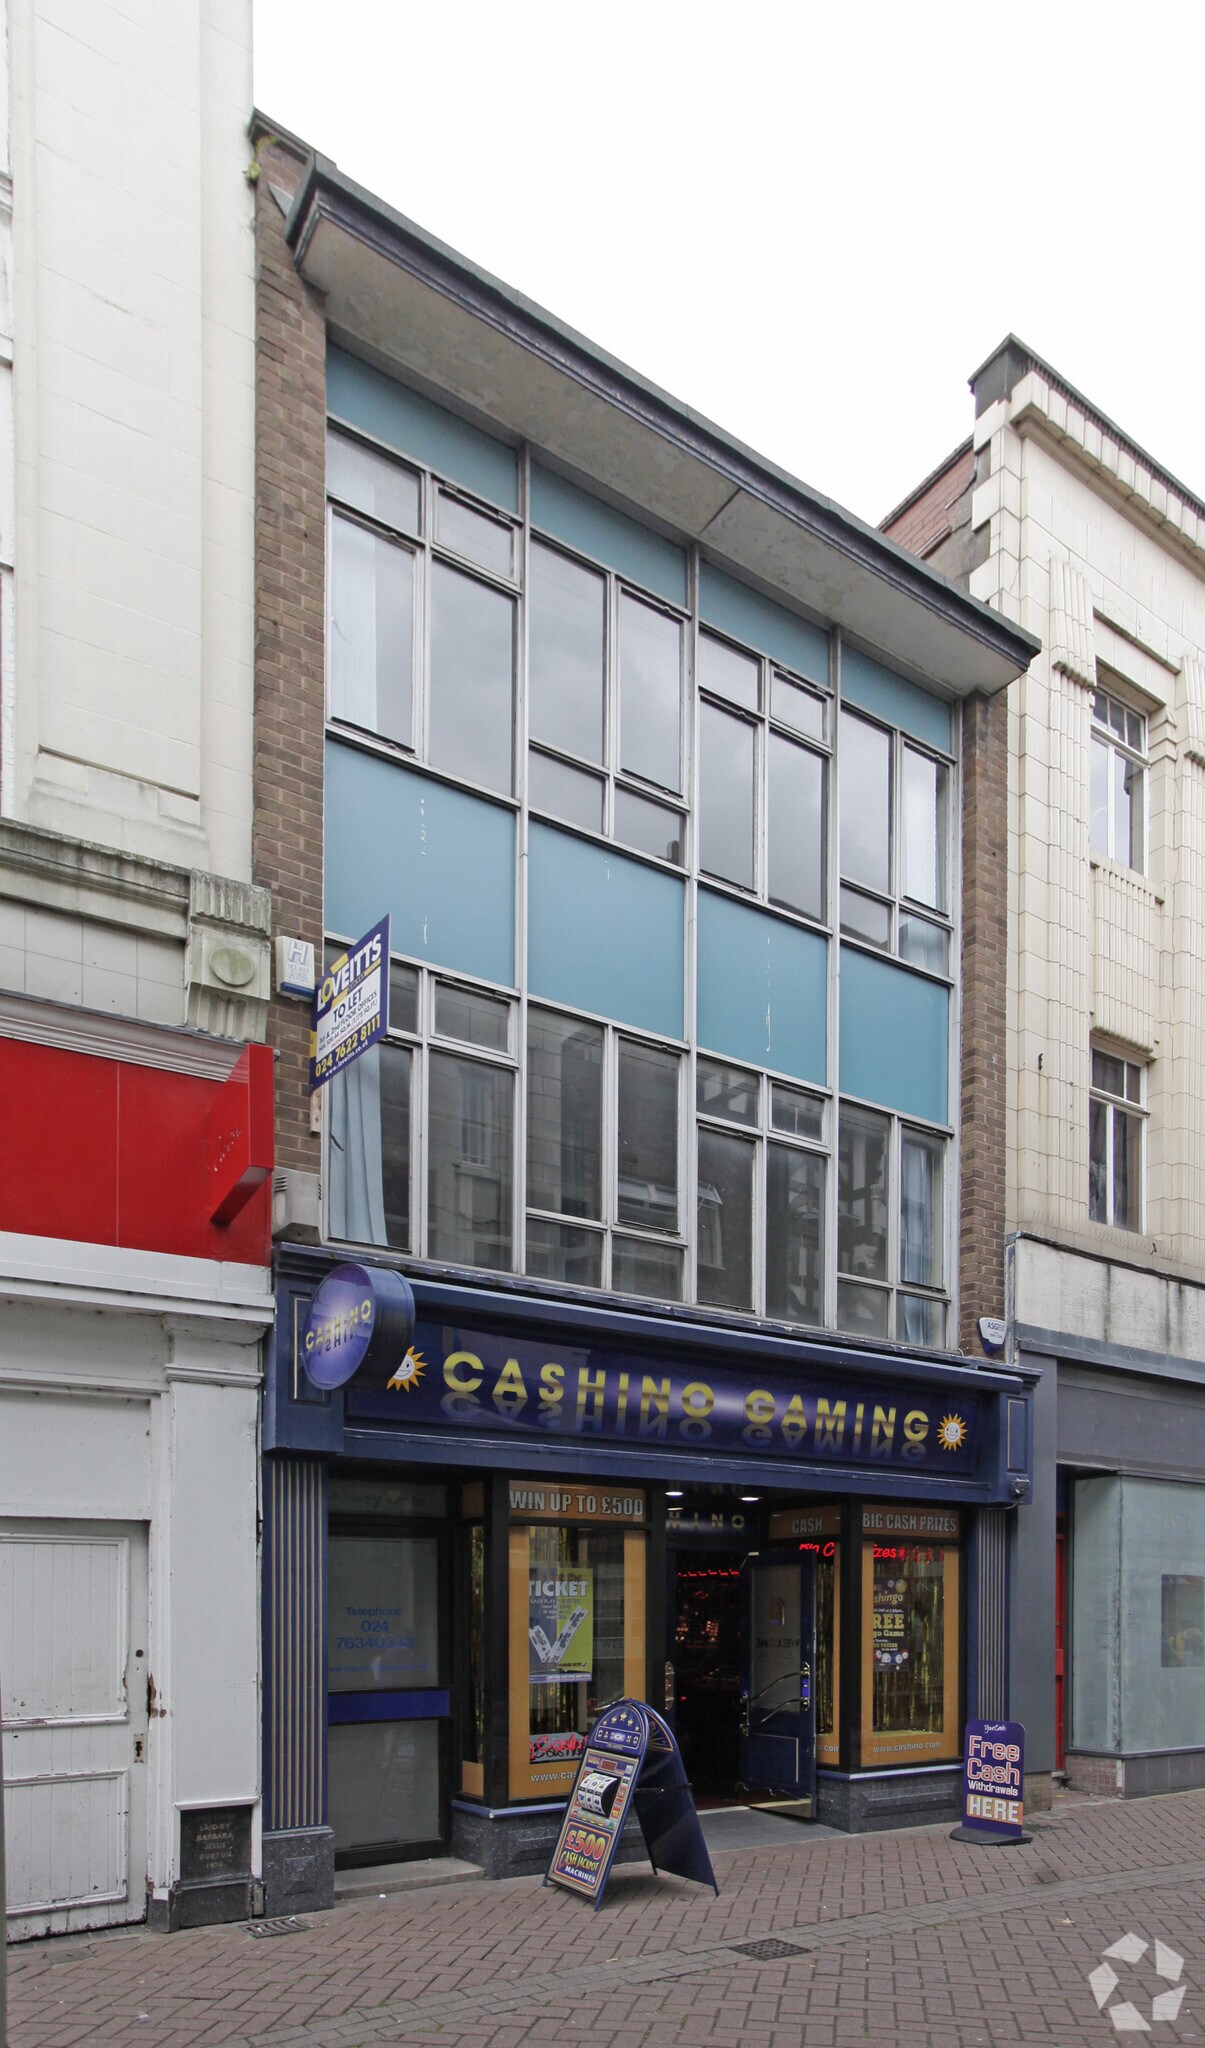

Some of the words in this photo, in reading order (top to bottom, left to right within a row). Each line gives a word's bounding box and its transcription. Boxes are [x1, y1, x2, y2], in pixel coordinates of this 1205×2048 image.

[316, 934, 381, 1013] LOVEITTS
[333, 1003, 346, 1023] TO
[348, 987, 363, 1010] LET
[341, 1009, 357, 1028] FLOOR
[357, 991, 378, 1013] OFFICES
[315, 1053, 333, 1077] 024
[335, 1032, 358, 1062] 7622
[360, 1013, 381, 1042] 8111
[305, 1299, 372, 1350] CASHINO
[442, 1351, 715, 1419] CASHINO
[745, 1389, 929, 1442] GAMING
[510, 1491, 545, 1511] WIN
[550, 1493, 572, 1512] UP
[576, 1495, 597, 1513] TO
[602, 1496, 643, 1516] £500
[792, 1517, 823, 1534] CASH
[862, 1512, 883, 1528] BIG
[886, 1514, 917, 1530] CASH
[920, 1516, 957, 1532] PRIZES
[529, 1580, 588, 1597] TICKET
[360, 1620, 389, 1633] 024
[873, 1613, 905, 1629] REE
[883, 1629, 905, 1638] Game
[536, 1733, 581, 1753] Cash
[873, 1741, 941, 1753] www.cashino.com
[968, 1735, 1020, 1762] Free
[967, 1757, 1020, 1785] Cash
[967, 1780, 1019, 1797] Withdrawals
[969, 1795, 1020, 1823] HERE
[196, 1832, 234, 1841] BARBARA
[200, 1823, 218, 1831] LAID
[565, 1829, 606, 1861] £500
[558, 1850, 578, 1868] CASH
[577, 1856, 600, 1872] JACKPOT
[564, 1865, 596, 1884] MACHINES
